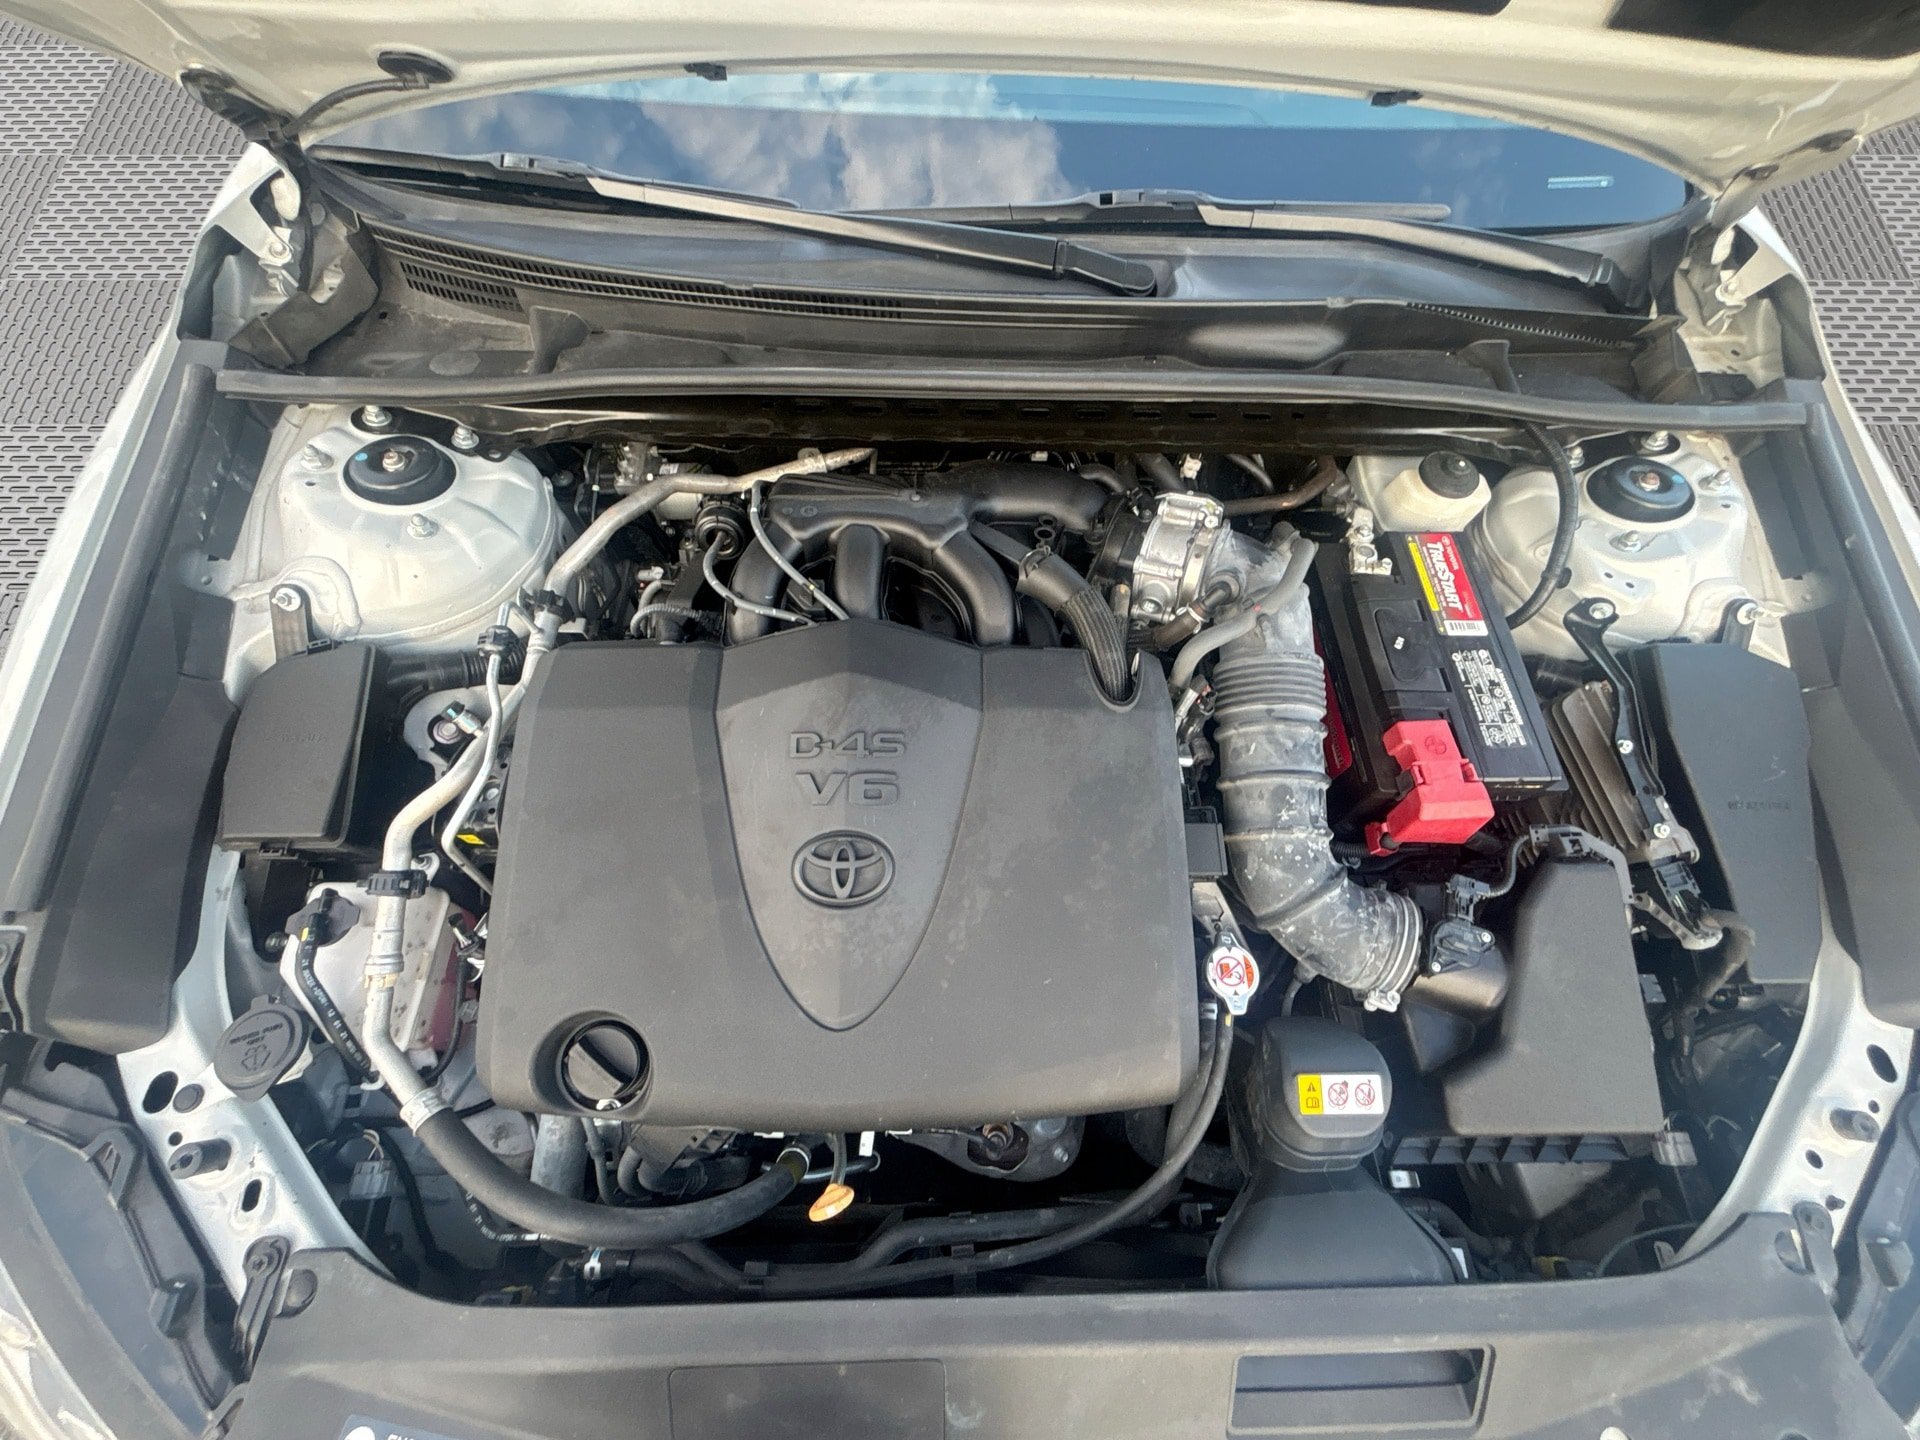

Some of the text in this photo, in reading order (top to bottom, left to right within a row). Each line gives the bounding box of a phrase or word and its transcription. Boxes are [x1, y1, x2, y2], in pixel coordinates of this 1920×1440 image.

[1446, 546, 1459, 571] TOYOTA
[789, 731, 906, 759] D-4S
[795, 771, 900, 806] V6
